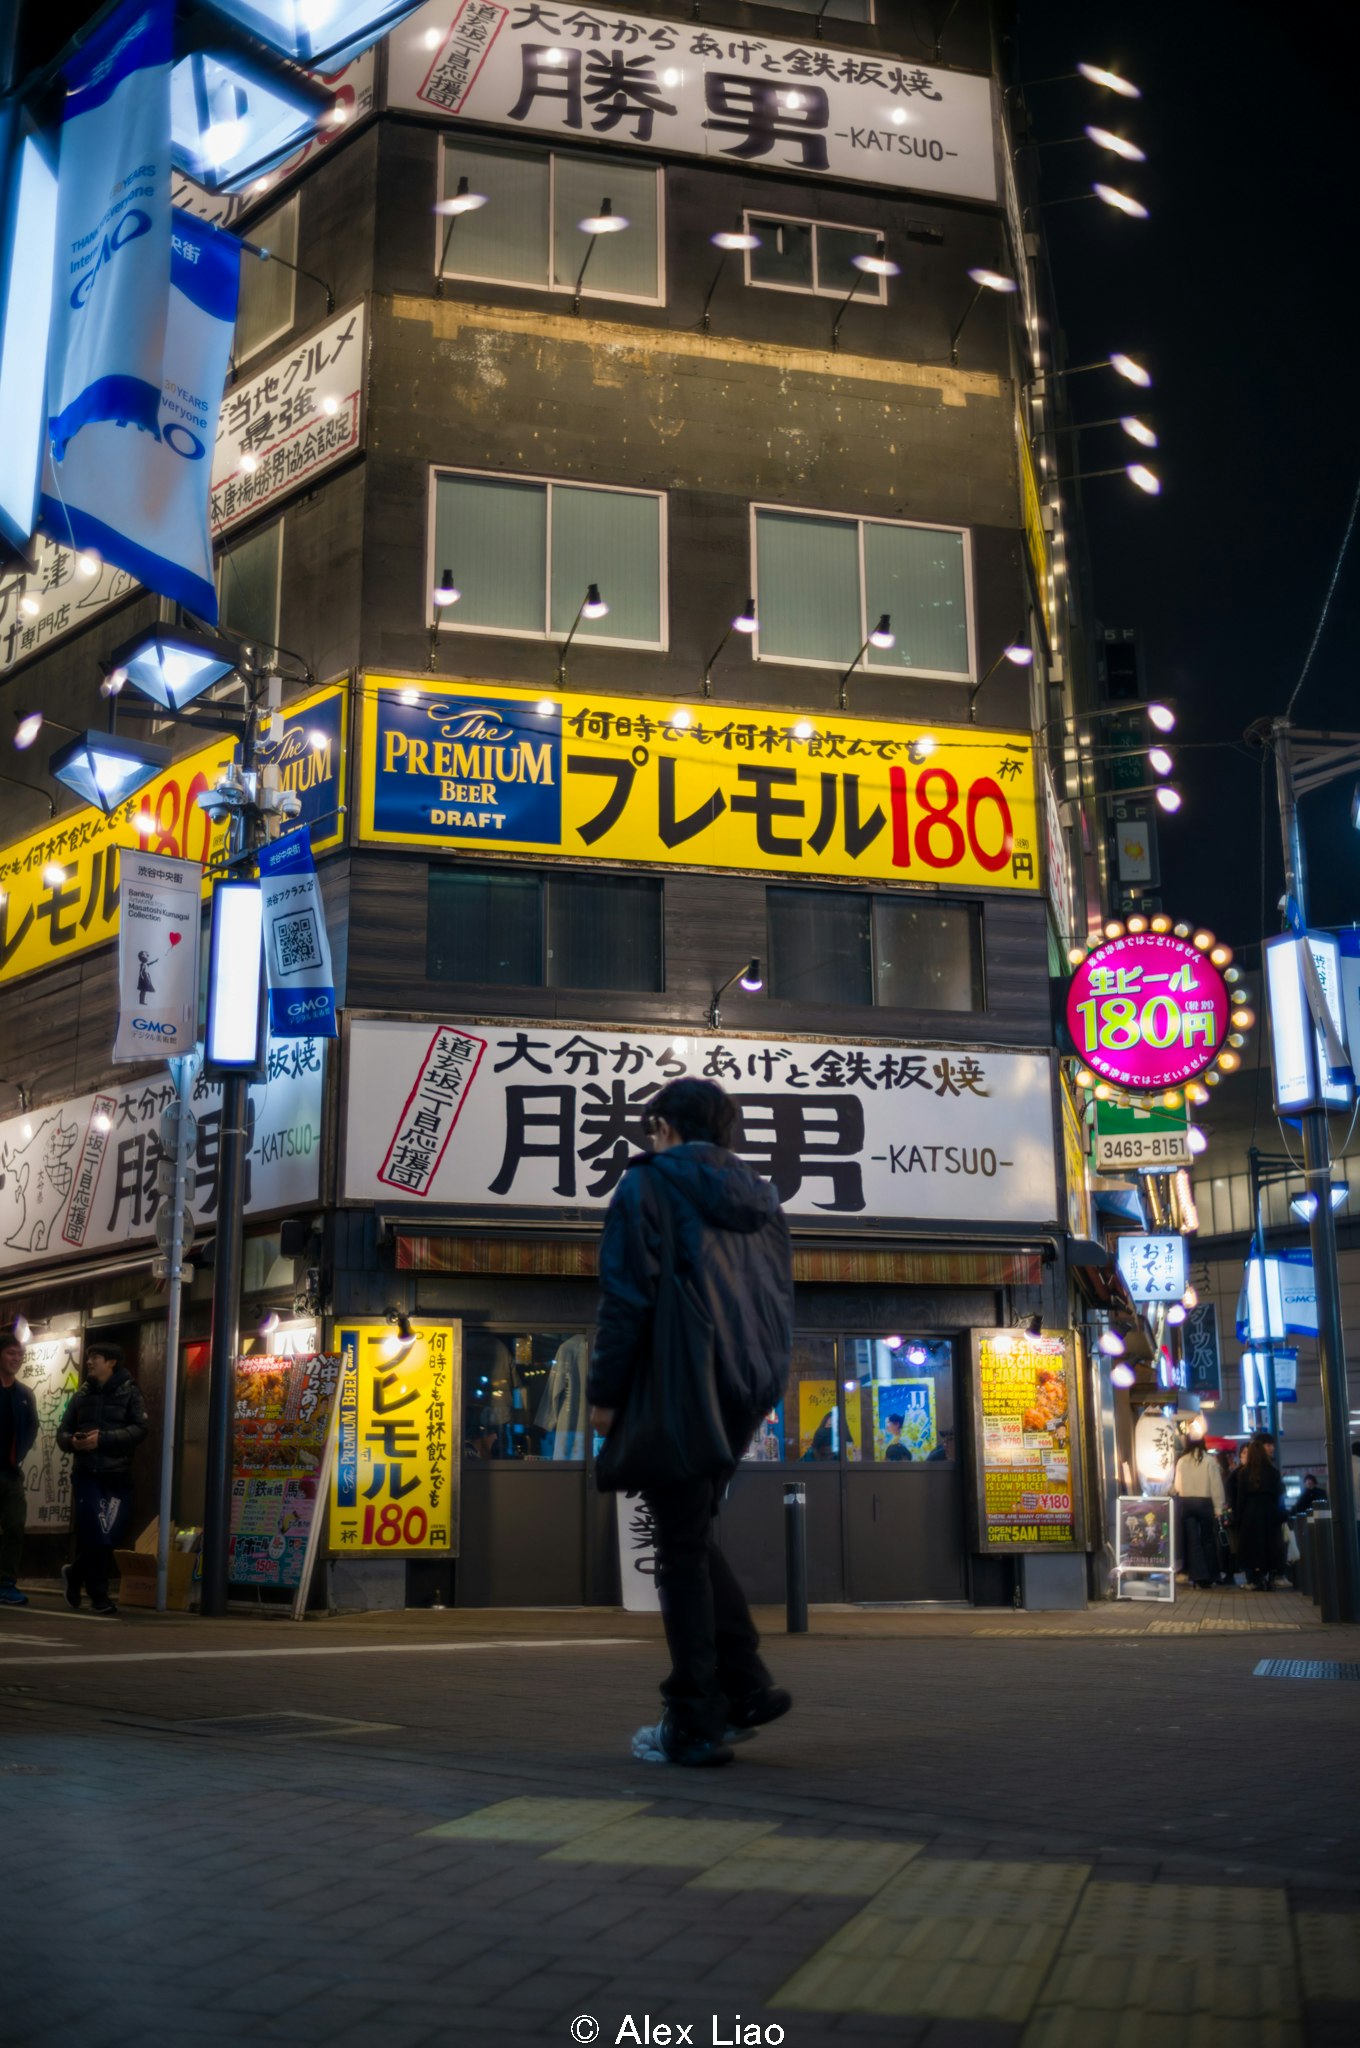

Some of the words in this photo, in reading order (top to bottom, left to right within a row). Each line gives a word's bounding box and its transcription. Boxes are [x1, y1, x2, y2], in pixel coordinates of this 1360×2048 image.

[508, 43, 830, 170] 勝男
[161, 396, 207, 429] veryone
[239, 386, 317, 453] 最強
[21, 602, 71, 649] 専門店
[427, 704, 513, 741] The
[280, 738, 333, 792] MIUM
[383, 731, 555, 785] PREMIUM
[440, 779, 499, 805] BEER
[567, 745, 888, 860] プレモル
[889, 766, 1013, 872] 180
[431, 810, 507, 829] DRAFT
[138, 866, 184, 884] 渋谷中央街
[128, 888, 154, 900] Banksy
[128, 903, 162, 915] Masatoshi
[162, 909, 190, 921] Kumagai
[128, 909, 162, 922] Collection
[1088, 963, 1199, 997] 生ビール
[287, 995, 329, 1016] GMO
[132, 1018, 177, 1035] GMO
[388, 1036, 477, 1189] 道玄坂二丁目応援団
[1104, 1138, 1185, 1159] 3463-8151
[66, 1101, 113, 1241] 道坂二丁目応援団
[1143, 1243, 1161, 1293] おでん
[1017, 1354, 1063, 1369] CHICKEN
[341, 1369, 357, 1406] BEER
[361, 1331, 424, 1501] プレモル
[425, 1332, 448, 1508] 何時でも何杯飲んでも
[341, 1411, 357, 1465] PREMIUM
[985, 1473, 1024, 1482] PREMIUM
[986, 1482, 994, 1490] IS
[996, 1482, 1013, 1490] LOW
[1015, 1482, 1043, 1491] PRICE!
[1041, 1494, 1070, 1509] ¥180
[362, 1503, 428, 1547] 180
[429, 1530, 447, 1546] 円
[987, 1525, 1012, 1534] OPEN
[1012, 1525, 1038, 1541] 5AM
[987, 1533, 1012, 1542] UNTIL
